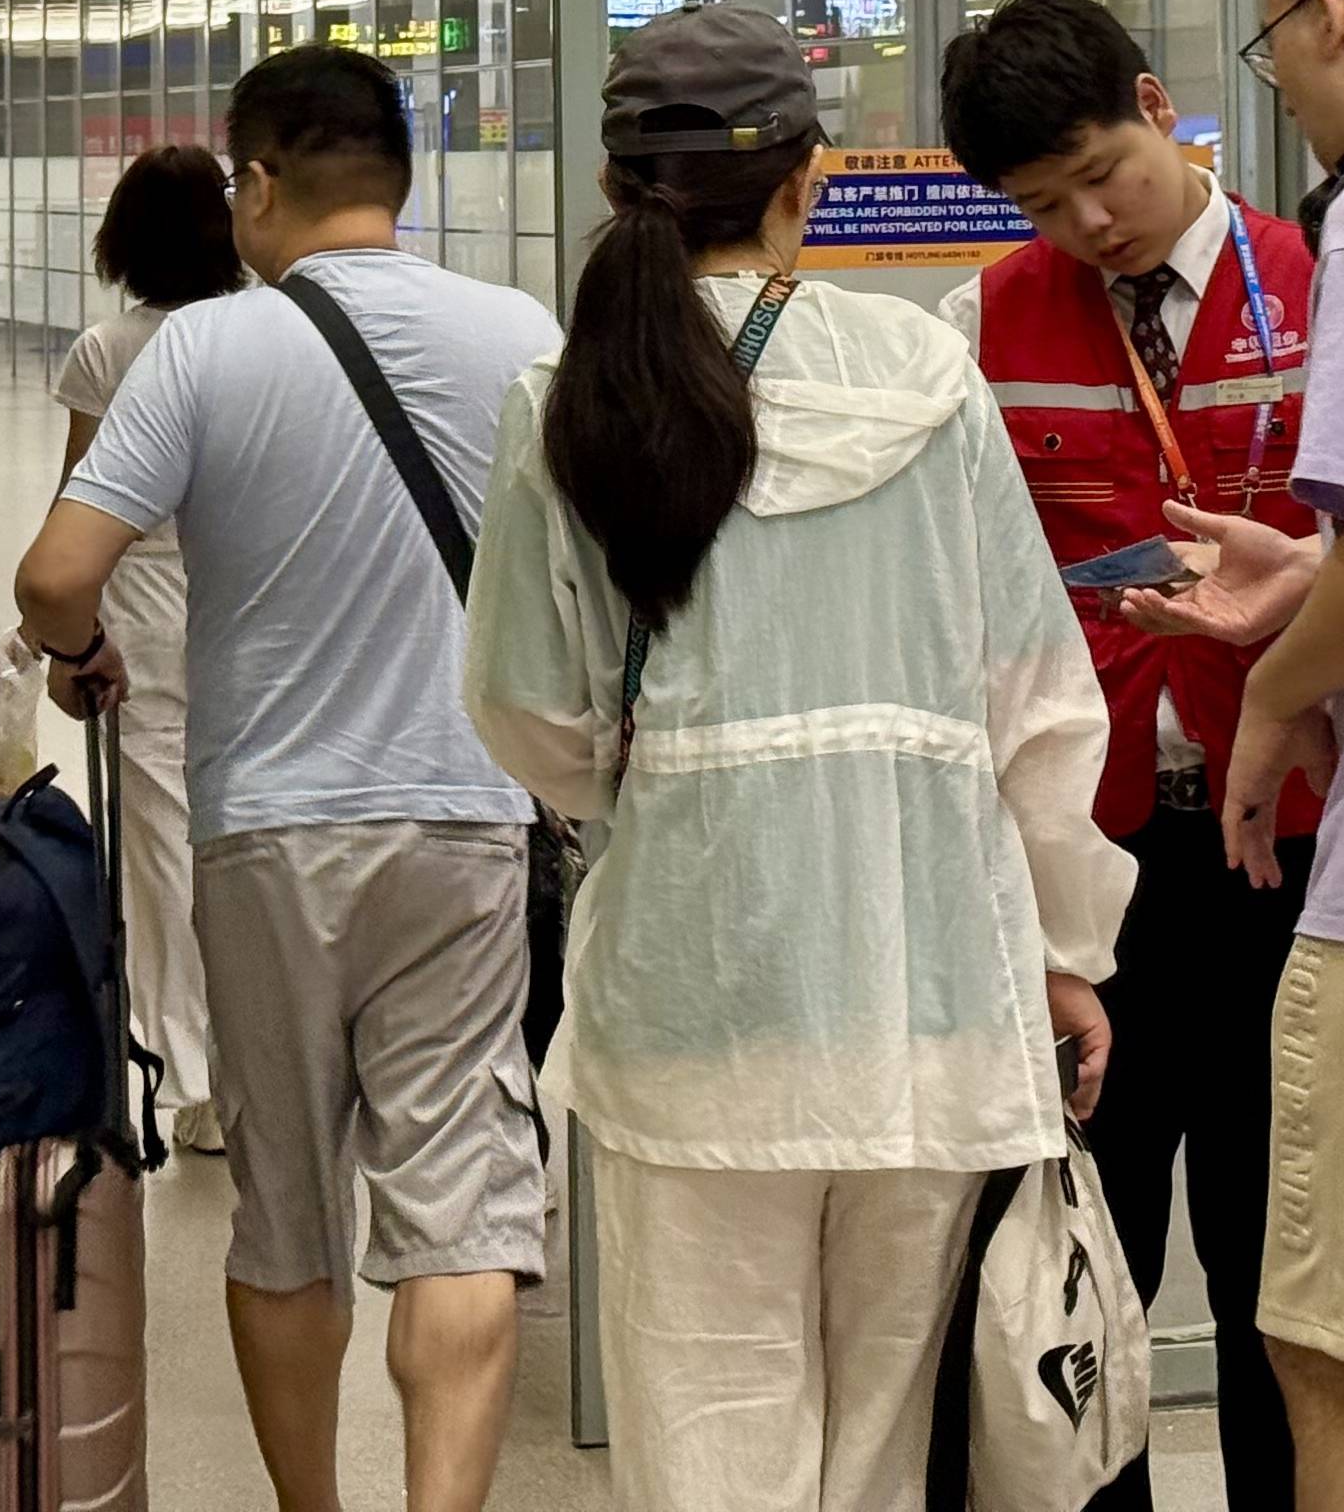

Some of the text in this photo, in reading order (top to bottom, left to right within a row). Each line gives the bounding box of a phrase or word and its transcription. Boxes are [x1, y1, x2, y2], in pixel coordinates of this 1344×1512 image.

[914, 155, 956, 168] ATTE
[808, 208, 854, 218] ENGERS
[856, 207, 879, 217] ARE
[880, 206, 947, 217] FORBIDDEN
[948, 205, 965, 216] TO
[966, 204, 997, 215] OPEN
[814, 224, 842, 234] WILL
[844, 223, 859, 233] BE
[861, 221, 942, 233] INVESTIGATED
[945, 221, 968, 232] FOR
[970, 220, 1006, 231] LEGAL
[1008, 220, 1033, 230] RES
